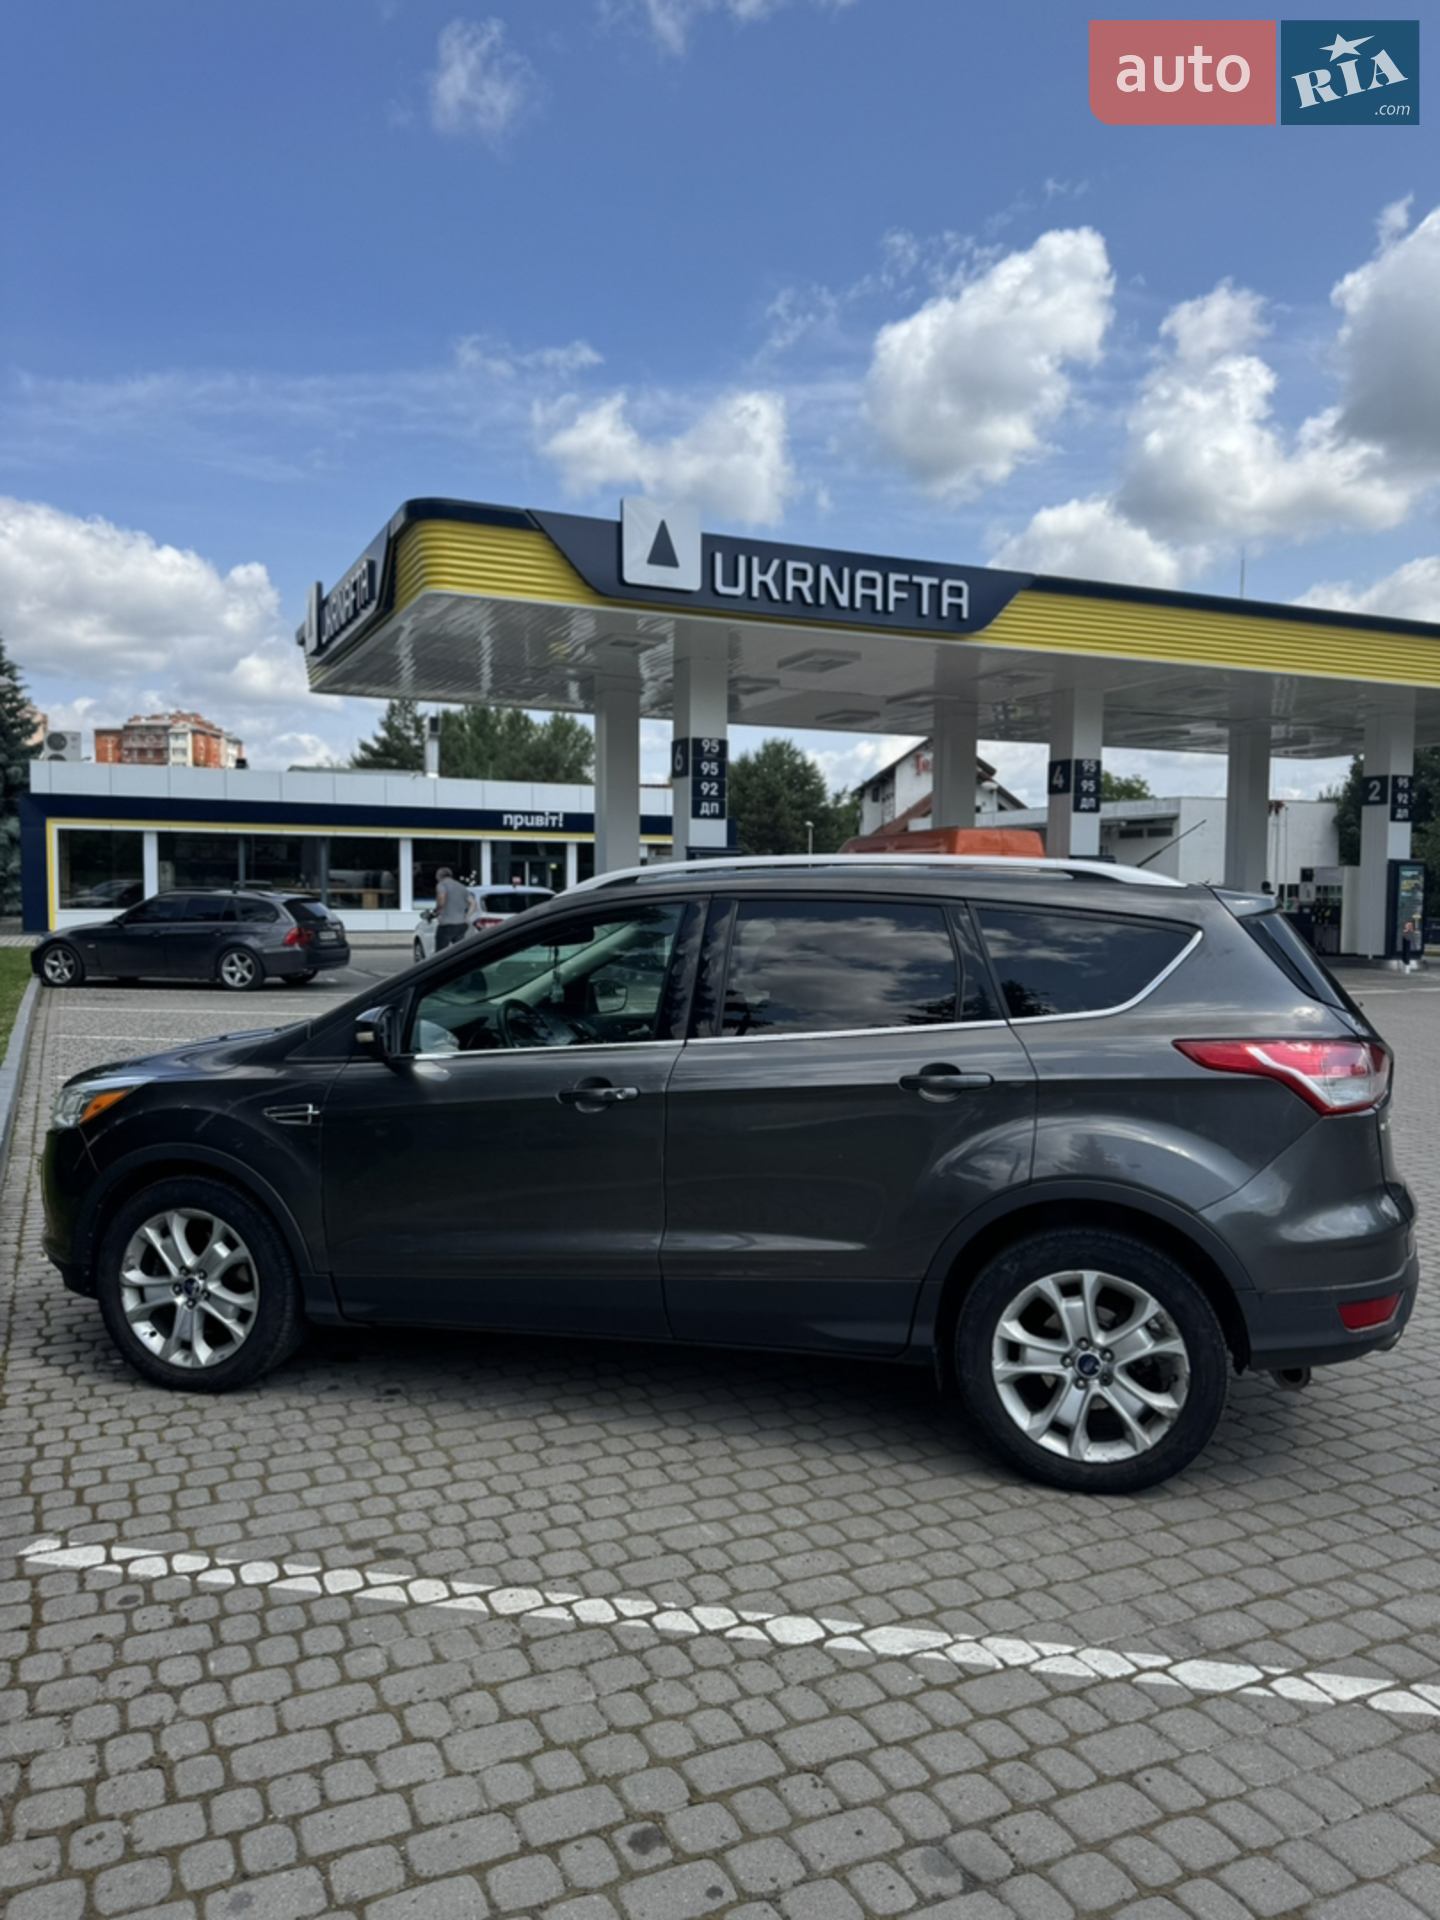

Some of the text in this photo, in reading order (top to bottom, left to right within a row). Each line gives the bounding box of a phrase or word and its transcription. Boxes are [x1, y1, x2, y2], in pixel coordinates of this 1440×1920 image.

[714, 551, 969, 619] UKRNAFTA
[702, 739, 720, 753] 95
[675, 745, 683, 771] 6
[701, 761, 719, 775] 95
[1082, 760, 1097, 772] 95
[1052, 765, 1064, 788] 4
[701, 782, 719, 796] 92
[1081, 780, 1096, 792] 95
[1368, 780, 1381, 801] 2
[1397, 792, 1409, 804] 92
[700, 802, 719, 816] ДП
[502, 811, 564, 831] привіт!
